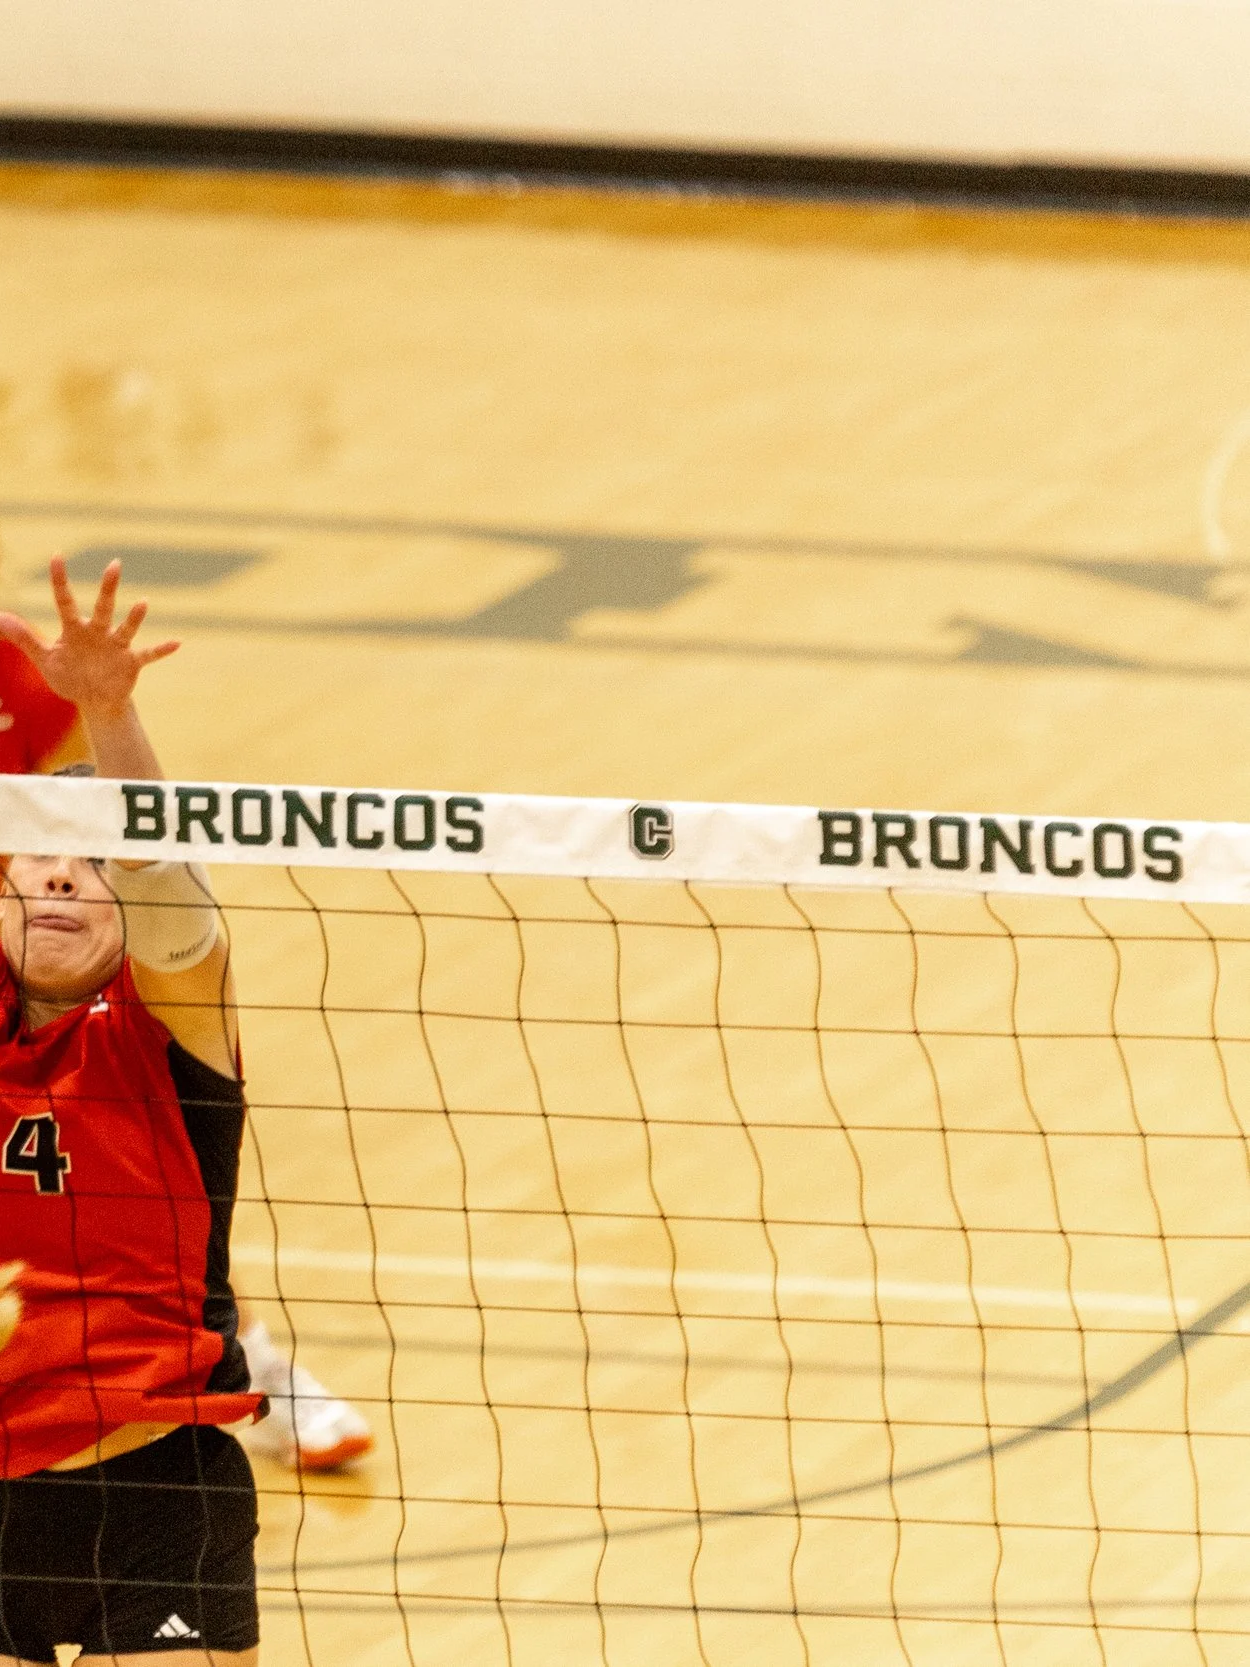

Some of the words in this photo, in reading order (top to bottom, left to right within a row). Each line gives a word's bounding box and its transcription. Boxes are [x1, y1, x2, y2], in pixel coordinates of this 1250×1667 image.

[121, 784, 484, 853] BRONCOS
[628, 803, 674, 860] C
[818, 811, 1182, 882] BRONCOS
[2, 1112, 71, 1196] 4
